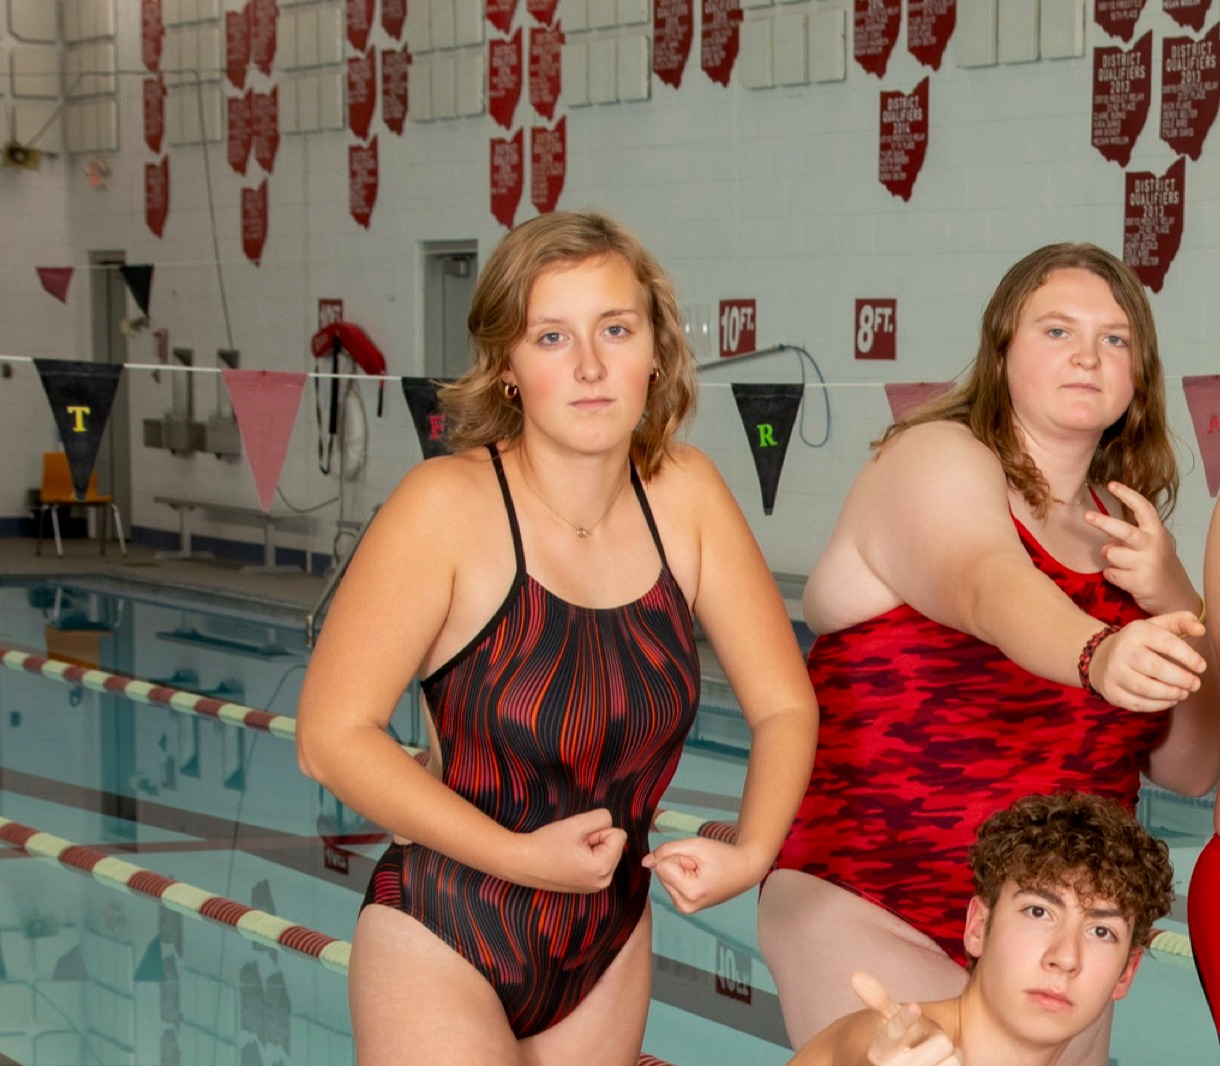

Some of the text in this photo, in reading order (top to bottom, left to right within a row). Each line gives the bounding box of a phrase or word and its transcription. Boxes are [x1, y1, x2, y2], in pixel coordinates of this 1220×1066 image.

[1171, 41, 1212, 59] DISTRICT
[1102, 52, 1141, 68] DISTRICT
[1165, 54, 1216, 72] QUALIFIERS
[1098, 65, 1146, 82] QUALIFIERS
[1181, 70, 1201, 84] 2013
[1110, 81, 1130, 93] 2013
[887, 96, 919, 110] DISTRICT
[882, 108, 923, 123] QUALIFIERS
[1135, 179, 1175, 192] DISTRICT
[1130, 191, 1180, 206] QUALIFIERS
[1143, 205, 1164, 218] 2013
[721, 306, 754, 352] 10FT.
[857, 305, 893, 353] 8FT.
[67, 406, 91, 432] T
[757, 424, 778, 447] R
